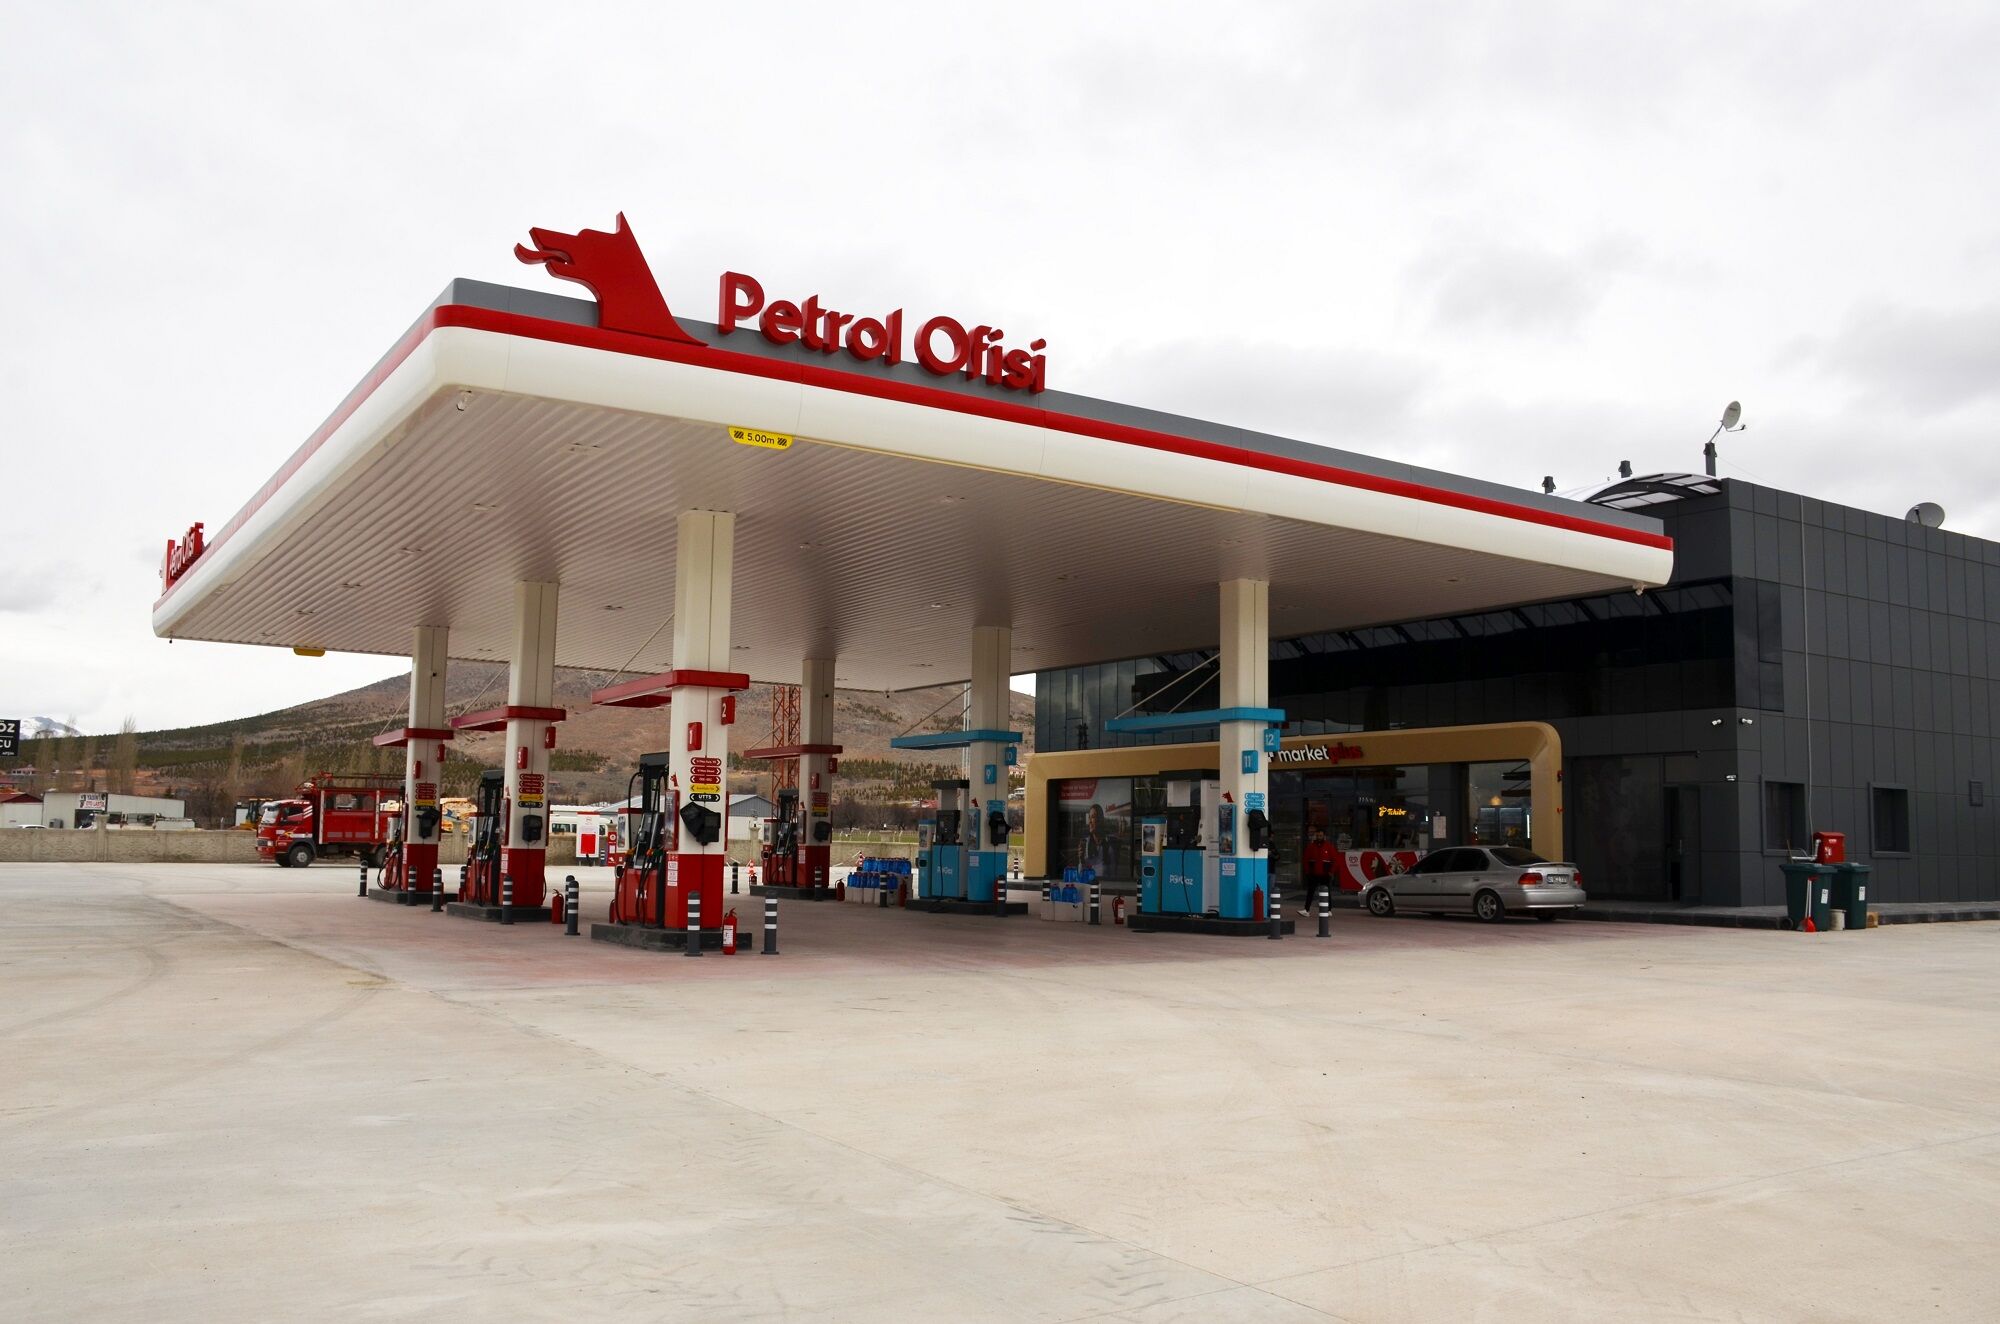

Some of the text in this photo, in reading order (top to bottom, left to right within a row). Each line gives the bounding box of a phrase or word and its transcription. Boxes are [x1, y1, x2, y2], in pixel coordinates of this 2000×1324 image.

[718, 271, 1047, 393] Petrol Ofisi
[747, 432, 775, 444] 5.00m
[721, 703, 727, 718] 2
[1265, 734, 1274, 746] 12
[1387, 808, 1407, 816] Tchibo
